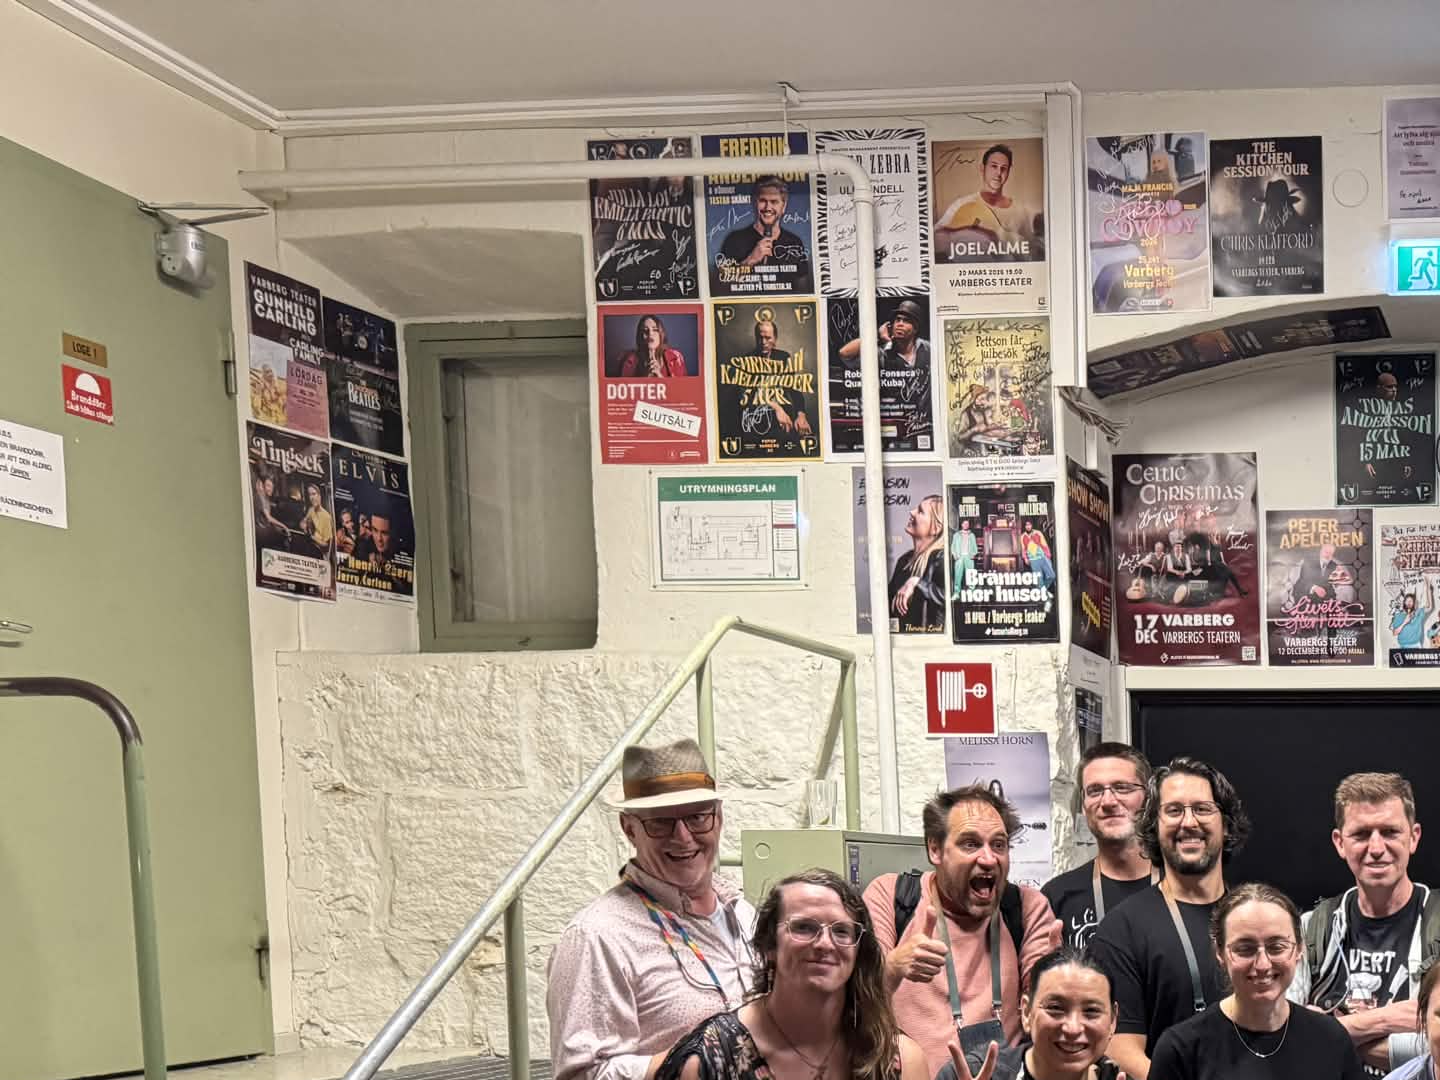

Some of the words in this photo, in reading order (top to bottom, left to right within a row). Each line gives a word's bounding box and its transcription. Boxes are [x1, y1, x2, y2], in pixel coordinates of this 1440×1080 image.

[1252, 142, 1276, 153] THE
[870, 154, 911, 173] ZEBRA
[1236, 152, 1292, 166] KITCHEN
[1224, 165, 1273, 178] SESSION
[1278, 163, 1308, 176] TOUR
[950, 243, 984, 259] JOEL
[988, 241, 1030, 255] ALME
[1221, 234, 1255, 250] CHRIS
[1124, 264, 1174, 279] Varberg
[950, 278, 997, 288] VARBERGS
[999, 278, 1032, 286] TEATER
[254, 288, 315, 322] GUNHILD
[255, 303, 317, 336] CARLING
[976, 336, 1007, 348] Pettson
[1010, 336, 1023, 346] får
[730, 349, 804, 374] CHRISTIAN
[981, 348, 1018, 361] julbesök
[880, 369, 916, 378] Fonseca
[607, 384, 666, 400] DOTTER
[1359, 397, 1414, 415] TOMAS
[641, 408, 694, 430] SLUTSÅLT
[1340, 406, 1432, 434] ANDERSSON
[253, 437, 325, 474] Tingsek
[1360, 443, 1374, 462] 15
[1376, 444, 1410, 460] MAR
[339, 458, 400, 489] ELVIS
[1126, 464, 1186, 484] Celtic
[680, 484, 776, 494] UTRYMNINGSPLAN
[1140, 484, 1245, 504] Christmas
[1288, 518, 1338, 534] PETER
[1280, 532, 1364, 550] APELGREN
[965, 569, 1041, 586] Bränner
[962, 587, 993, 602] ner
[996, 586, 1048, 602] huset
[1134, 614, 1159, 629] 17
[1162, 614, 1235, 626] VARBERG
[1135, 629, 1159, 644] DEC
[1162, 631, 1204, 644] VARBERGS
[1206, 631, 1241, 644] TEATERN
[1284, 637, 1328, 648] VARBERGS
[1330, 636, 1357, 646] TEATER
[1002, 736, 1033, 746] HORN
